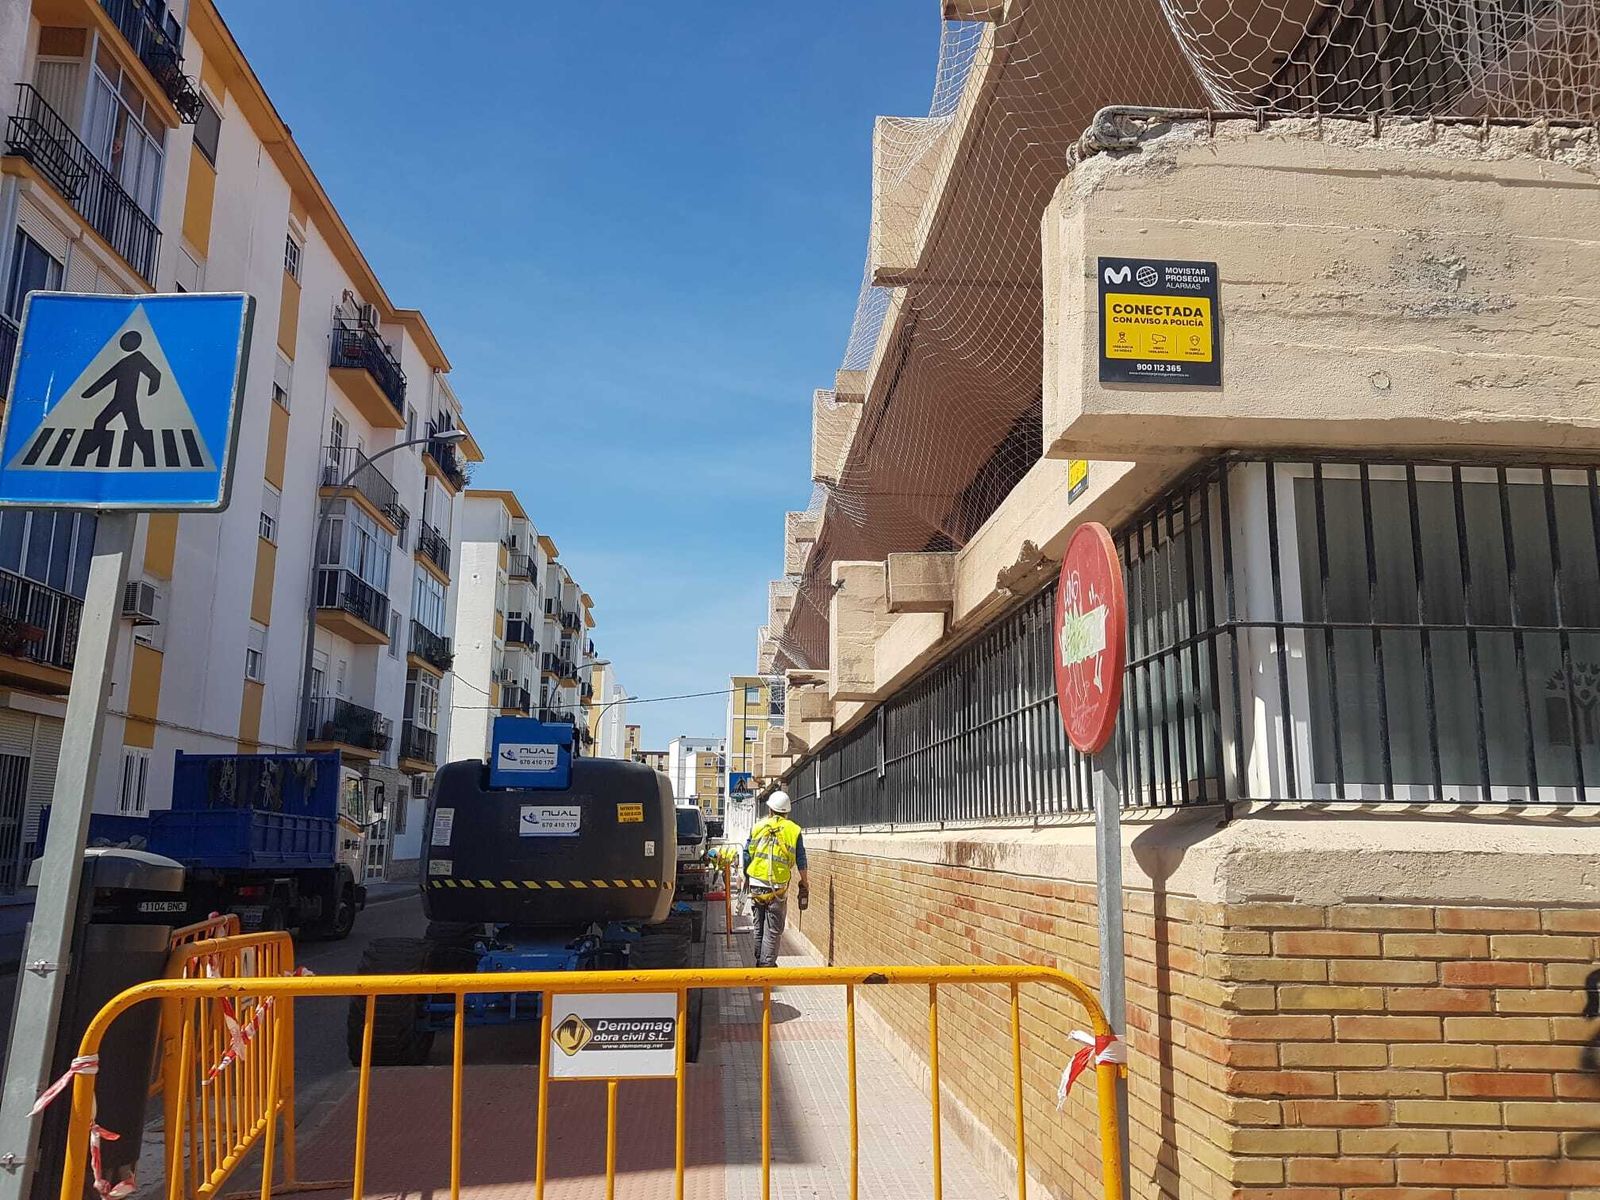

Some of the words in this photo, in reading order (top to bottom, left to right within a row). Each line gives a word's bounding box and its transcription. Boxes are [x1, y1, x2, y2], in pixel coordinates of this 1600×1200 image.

[1165, 267, 1206, 275] MOVISTAR
[1165, 274, 1210, 283] PROSEGUR
[1166, 282, 1201, 290] ALARMAS
[1112, 303, 1204, 318] CONECTADA
[1134, 317, 1161, 325] AVISO
[1170, 318, 1204, 327] POLICÍA
[1136, 363, 1152, 371] 900
[1166, 364, 1182, 372] 365
[145, 902, 165, 911] 1104
[597, 1020, 673, 1033] Demomag
[593, 1033, 619, 1042] obra
[622, 1032, 646, 1041] civil
[648, 1031, 669, 1041] S.L.
